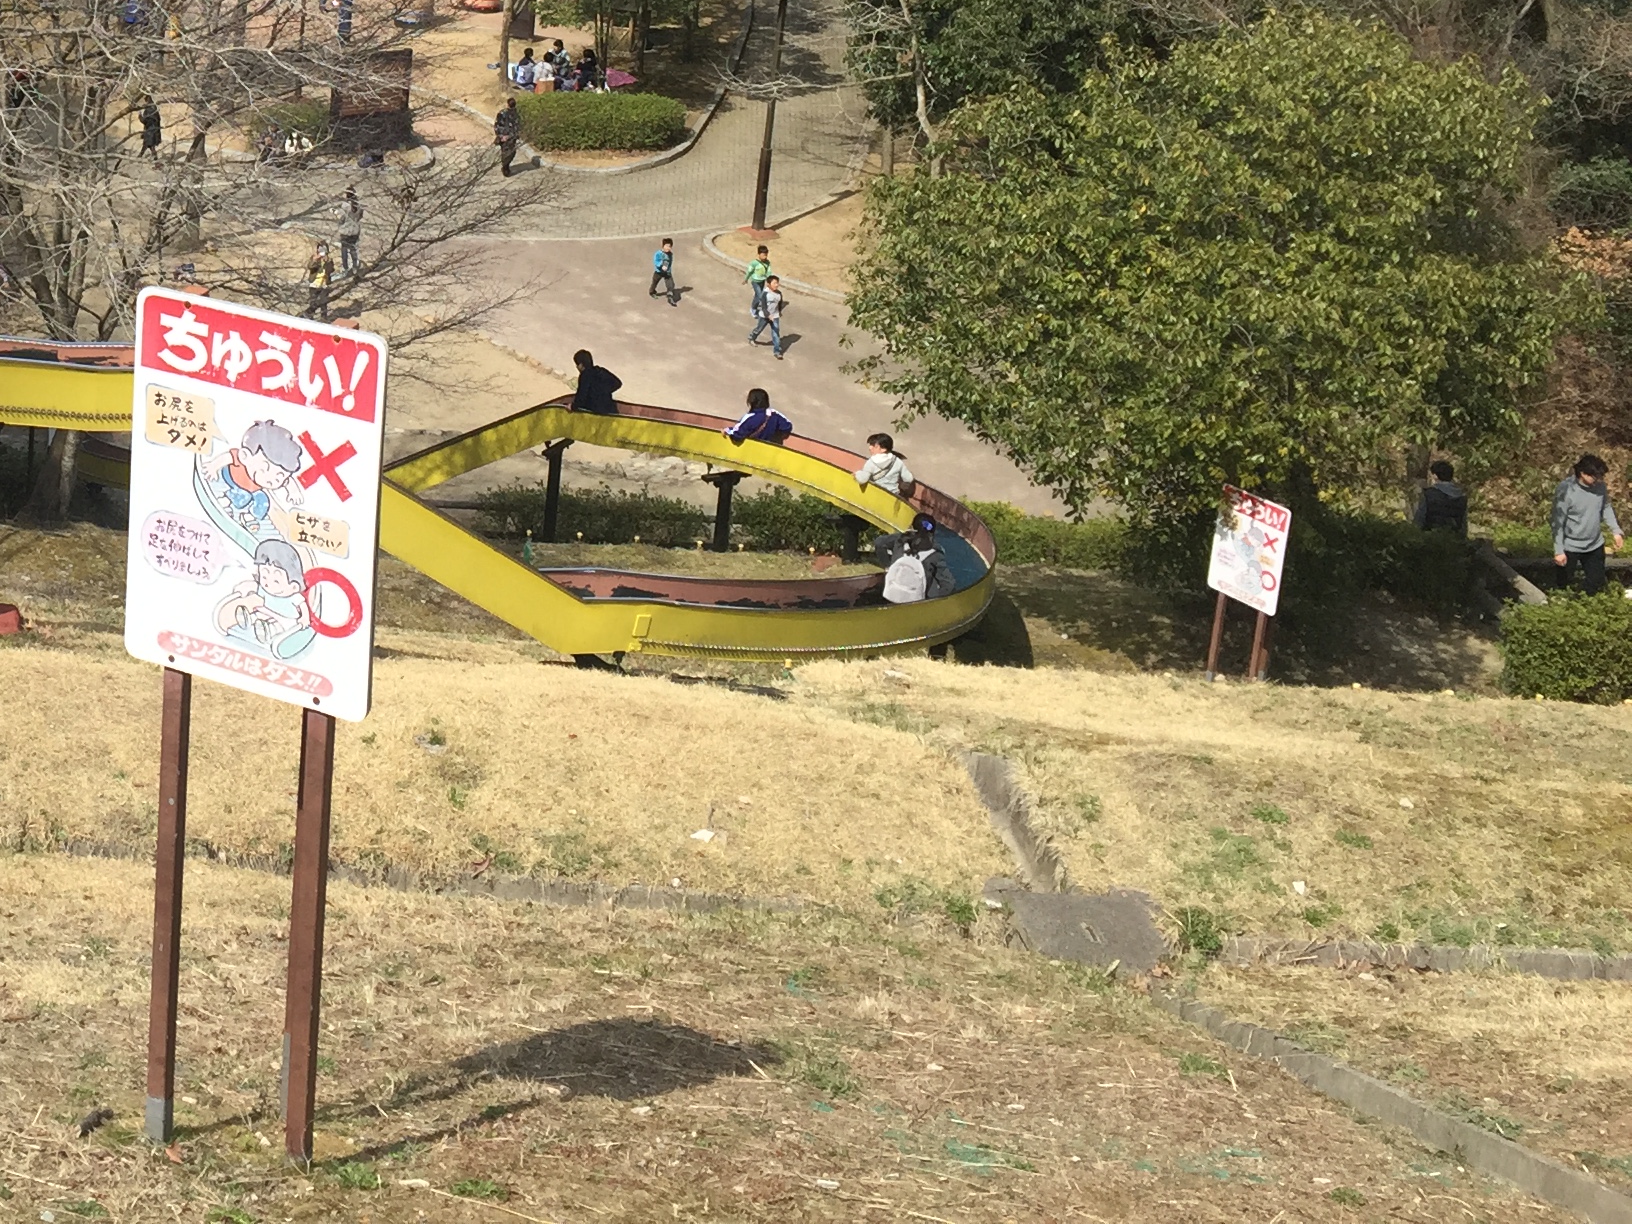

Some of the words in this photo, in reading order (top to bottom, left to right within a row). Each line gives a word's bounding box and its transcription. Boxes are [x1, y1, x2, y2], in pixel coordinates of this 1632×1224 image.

[157, 309, 371, 413] ちゅうい!
[153, 390, 195, 414] お尻を
[156, 411, 208, 432] 上げるのは
[167, 428, 208, 451] ダメ!
[295, 512, 331, 533] ヒザを
